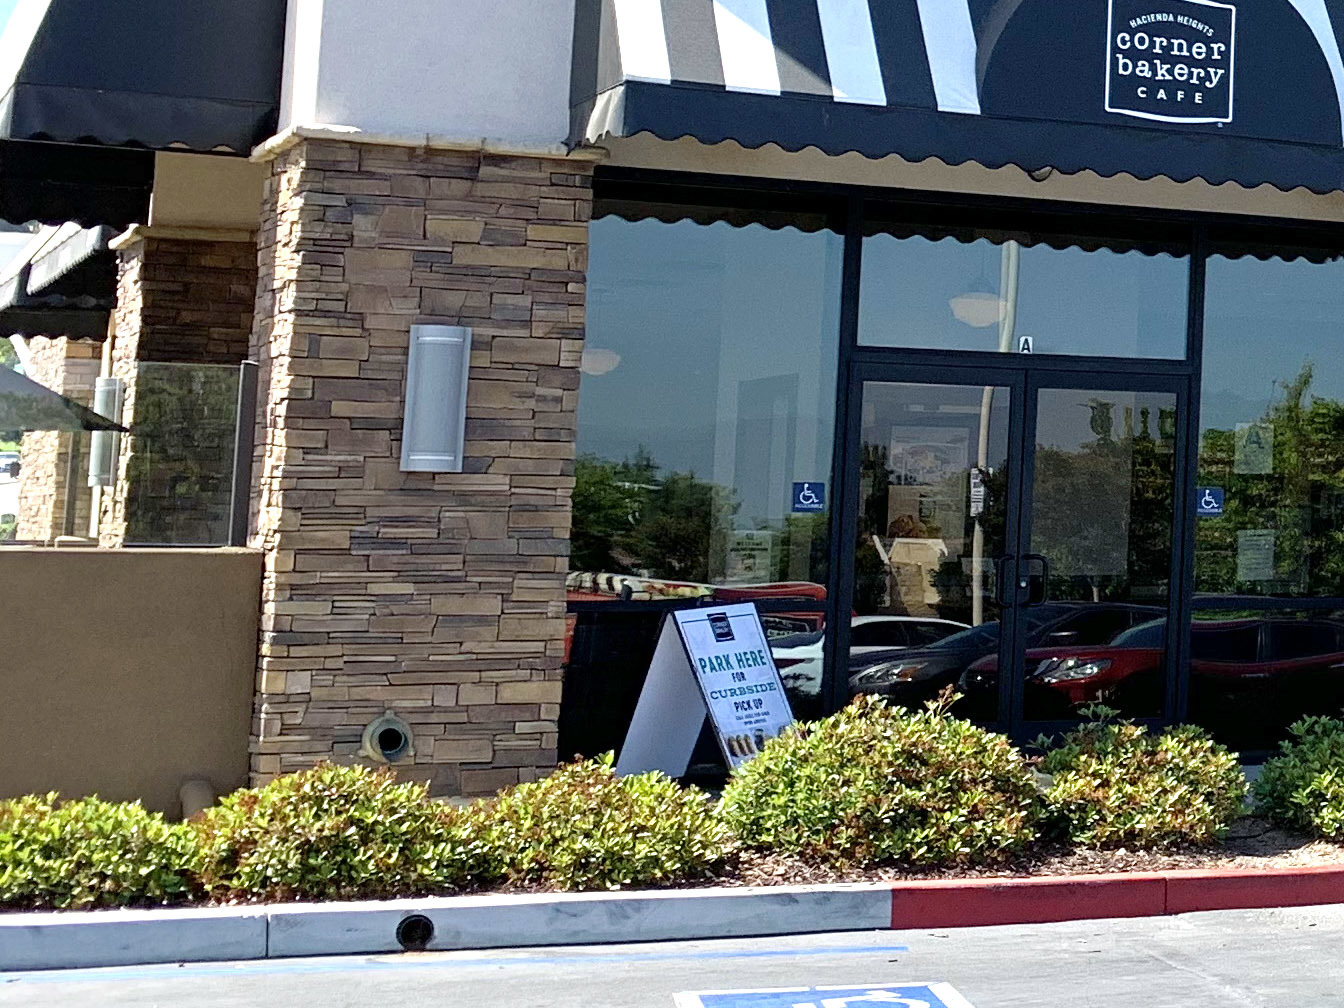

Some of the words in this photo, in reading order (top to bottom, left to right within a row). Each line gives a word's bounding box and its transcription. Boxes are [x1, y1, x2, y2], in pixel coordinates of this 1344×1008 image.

[1129, 12, 1175, 29] HACIENDA
[1177, 14, 1214, 37] HEIGHTS
[1116, 32, 1226, 60] corner
[1115, 53, 1225, 88] bakery
[1136, 86, 1203, 104] CAFE
[1020, 337, 1031, 353] A
[698, 653, 734, 675] PARK
[734, 649, 767, 670] HERE
[731, 671, 747, 683] FOR
[709, 681, 777, 701] CURBSIDE
[733, 699, 753, 712] PICK
[752, 697, 763, 710] UP
